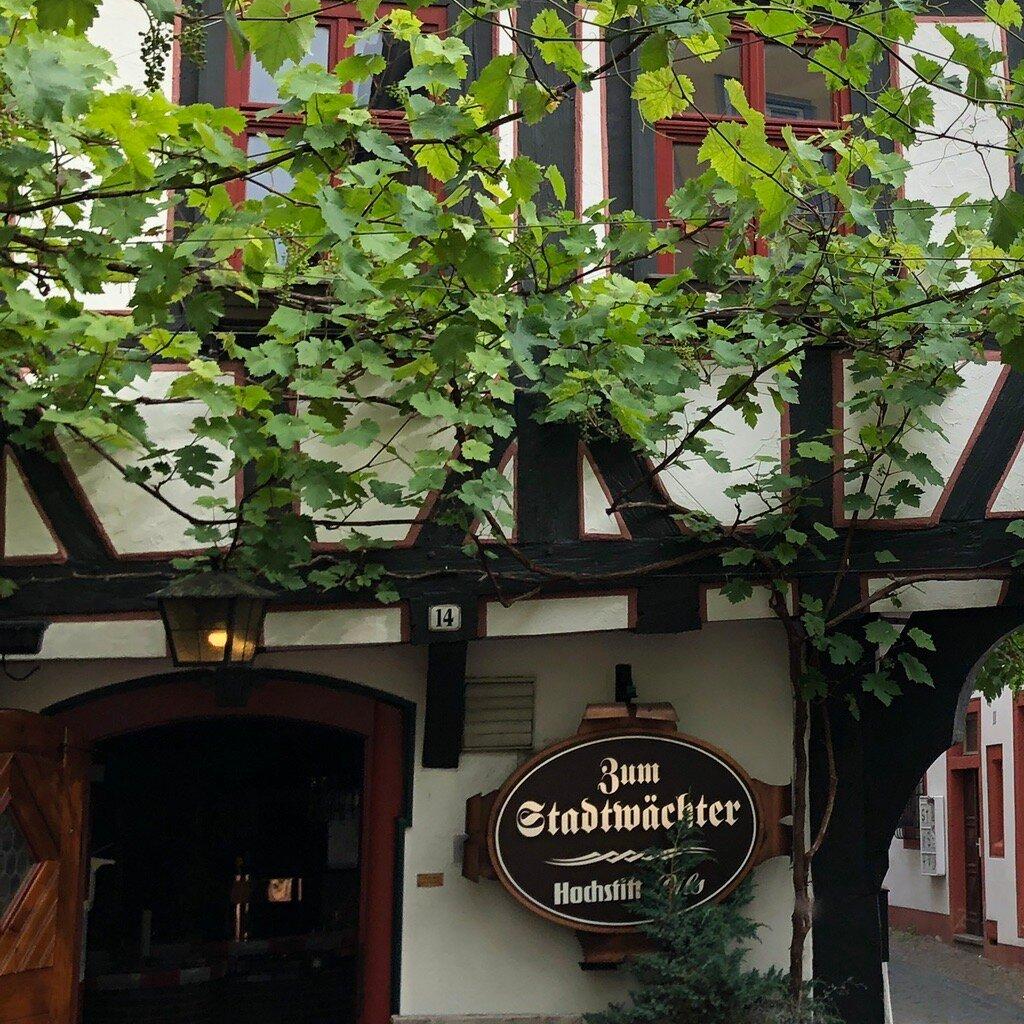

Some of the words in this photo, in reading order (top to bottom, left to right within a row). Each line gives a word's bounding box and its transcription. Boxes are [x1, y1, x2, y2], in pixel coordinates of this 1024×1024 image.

[436, 608, 455, 627] 14
[597, 757, 660, 795] Zum
[516, 792, 742, 838] Stadtwächter
[553, 878, 643, 906] Hochstift
